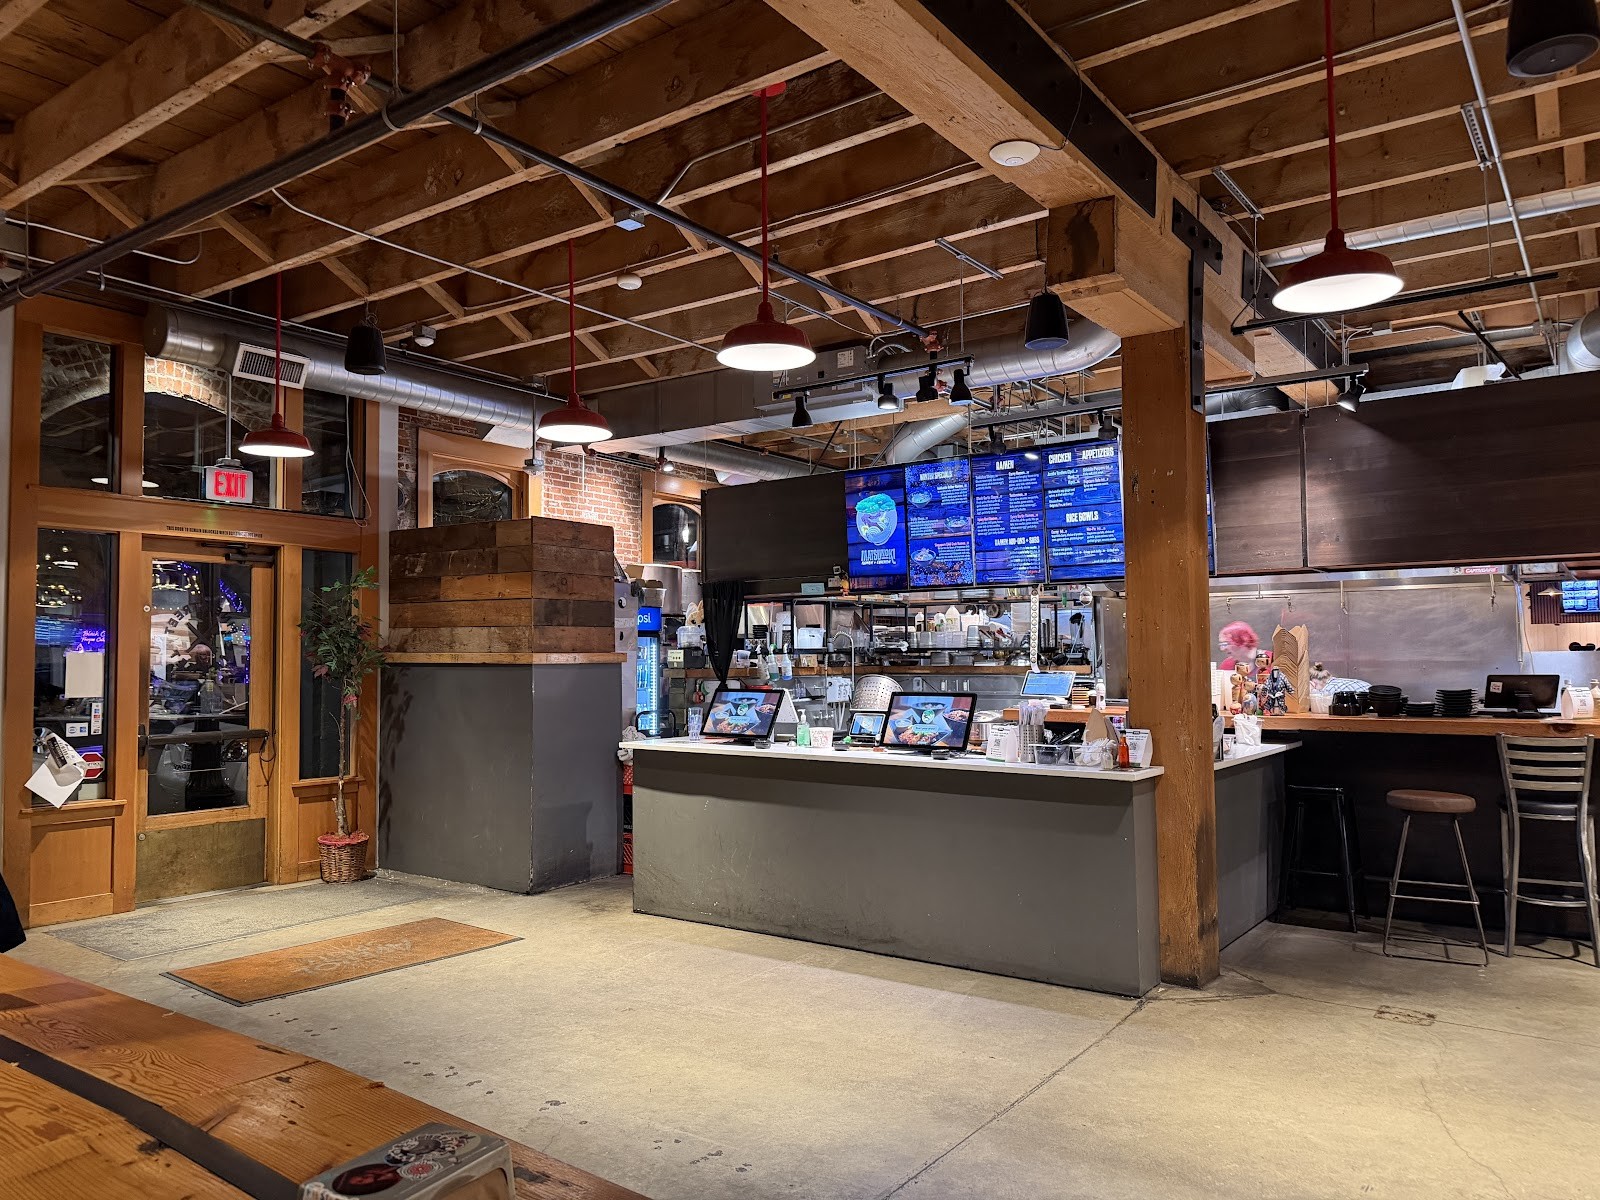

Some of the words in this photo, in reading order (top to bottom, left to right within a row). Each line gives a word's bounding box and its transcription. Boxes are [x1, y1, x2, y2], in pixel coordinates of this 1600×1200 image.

[1048, 452, 1072, 465] CHICKEN
[1082, 446, 1115, 460] APPETIZERS
[995, 460, 1015, 471] RAMEN
[214, 470, 248, 499] EXIT
[1065, 512, 1079, 523] RICE
[1079, 511, 1099, 522] BOWLS
[637, 612, 652, 626] psi
